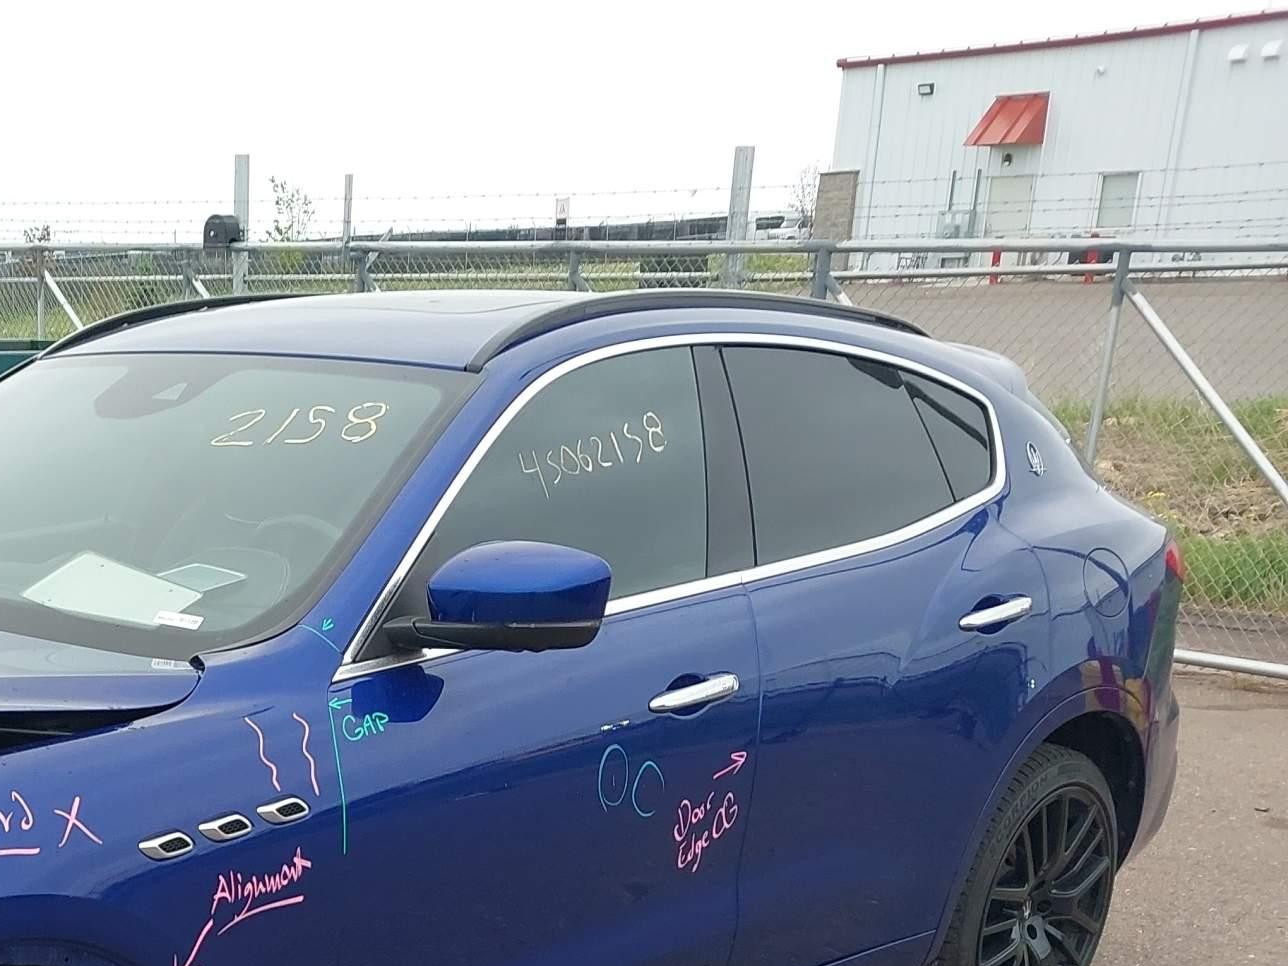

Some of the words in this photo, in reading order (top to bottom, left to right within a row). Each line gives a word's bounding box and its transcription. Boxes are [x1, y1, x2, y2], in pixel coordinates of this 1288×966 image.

[210, 402, 389, 446] 2158
[518, 411, 667, 499] 45062158
[342, 712, 390, 741] GAP
